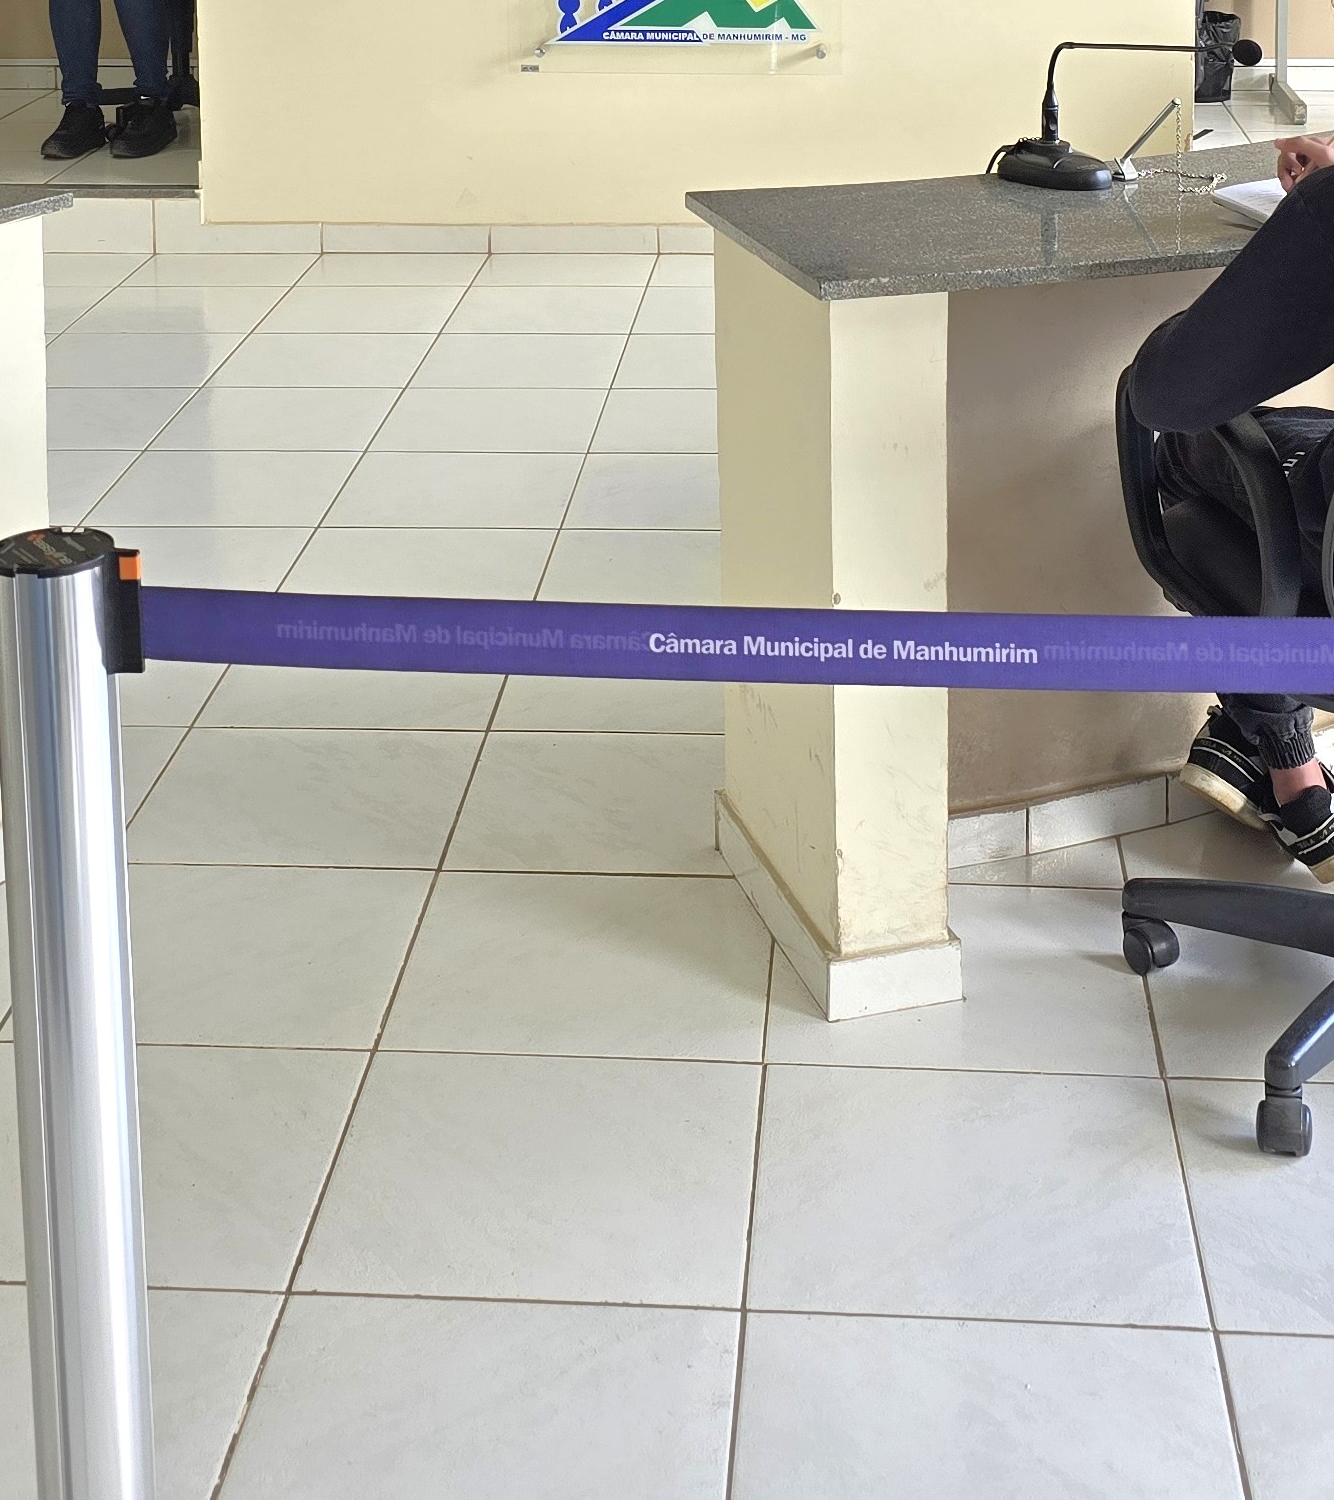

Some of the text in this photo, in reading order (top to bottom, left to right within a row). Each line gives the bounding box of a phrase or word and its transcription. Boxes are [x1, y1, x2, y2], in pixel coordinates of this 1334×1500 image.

[602, 30, 645, 40] CÂMARA
[646, 32, 700, 41] MUNICIPAL
[702, 33, 715, 41] DE
[717, 33, 783, 41] MANHUMIRIM
[791, 33, 807, 41] MG
[648, 632, 1039, 664] Câmara Municipal de Manhumirim
